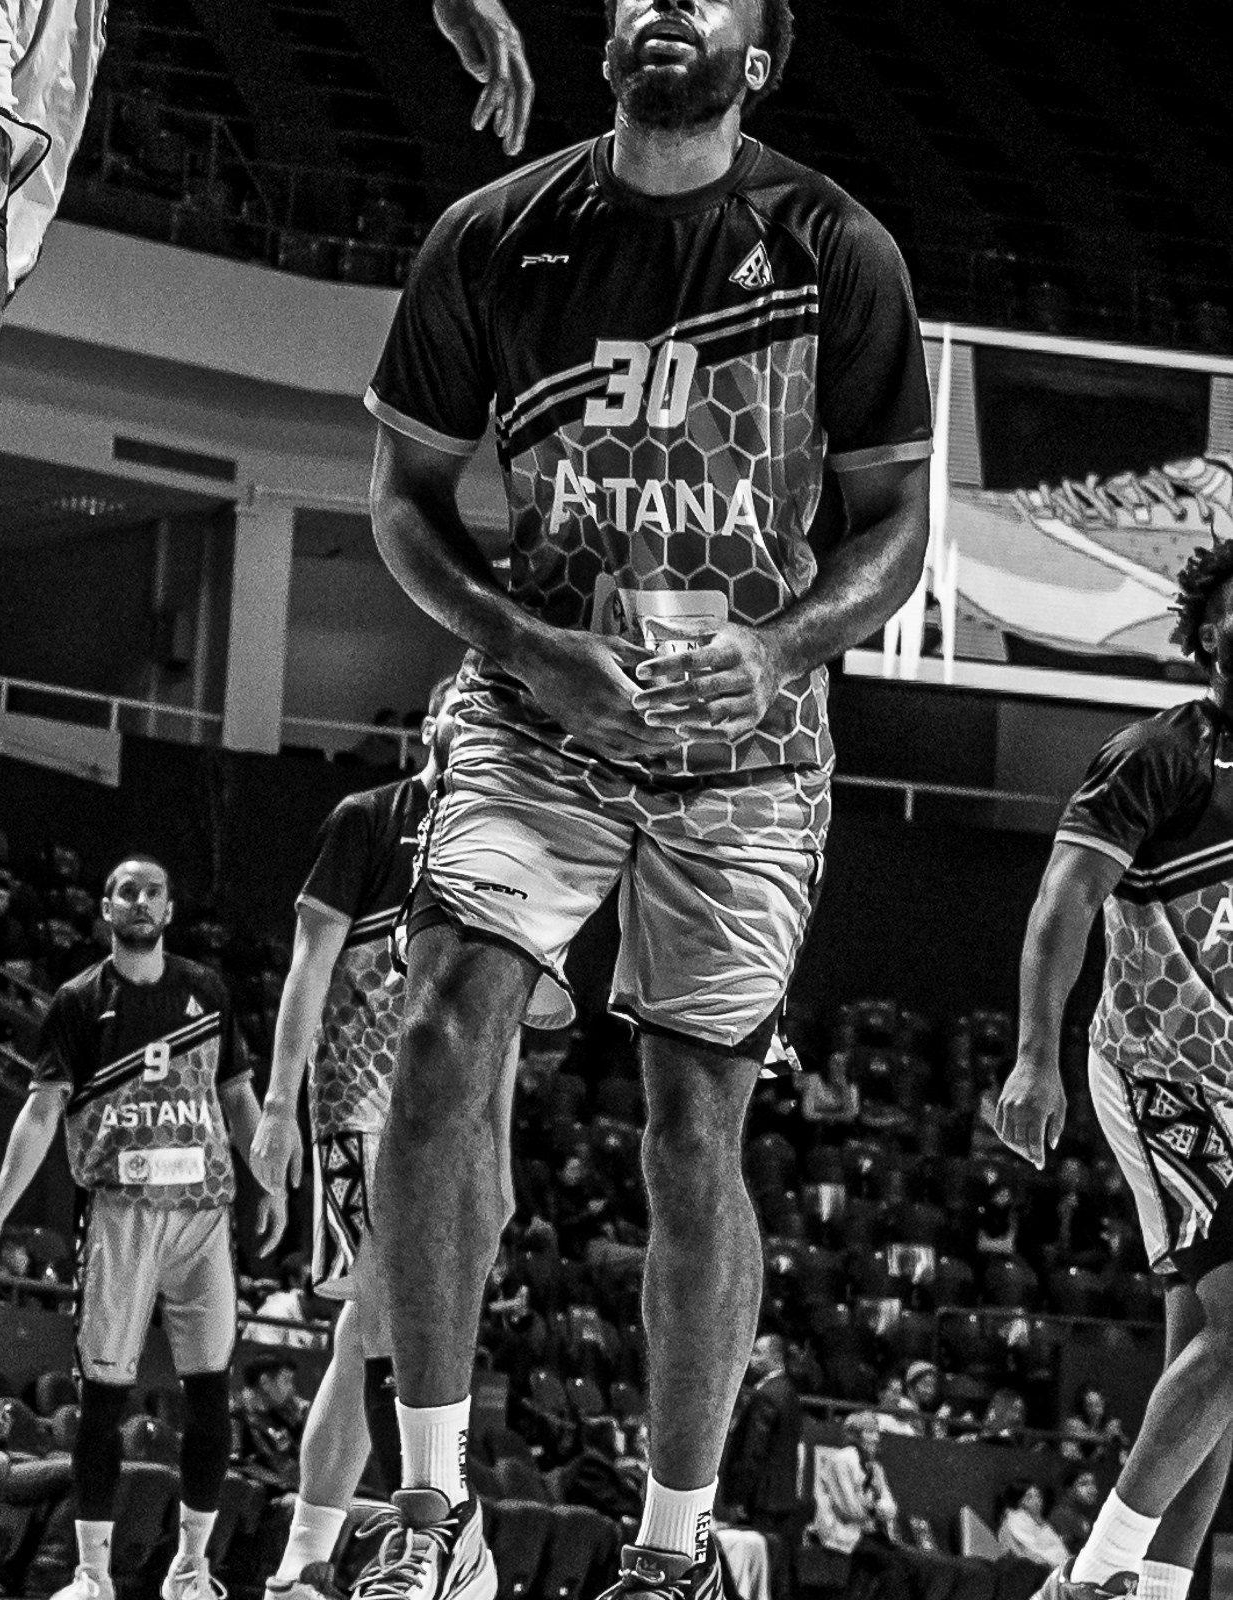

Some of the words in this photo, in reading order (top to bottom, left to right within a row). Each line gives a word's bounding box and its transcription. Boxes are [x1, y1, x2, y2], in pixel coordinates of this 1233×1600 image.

[583, 338, 699, 428] 30
[143, 1041, 171, 1083] 9
[96, 1099, 213, 1141] ASTANA
